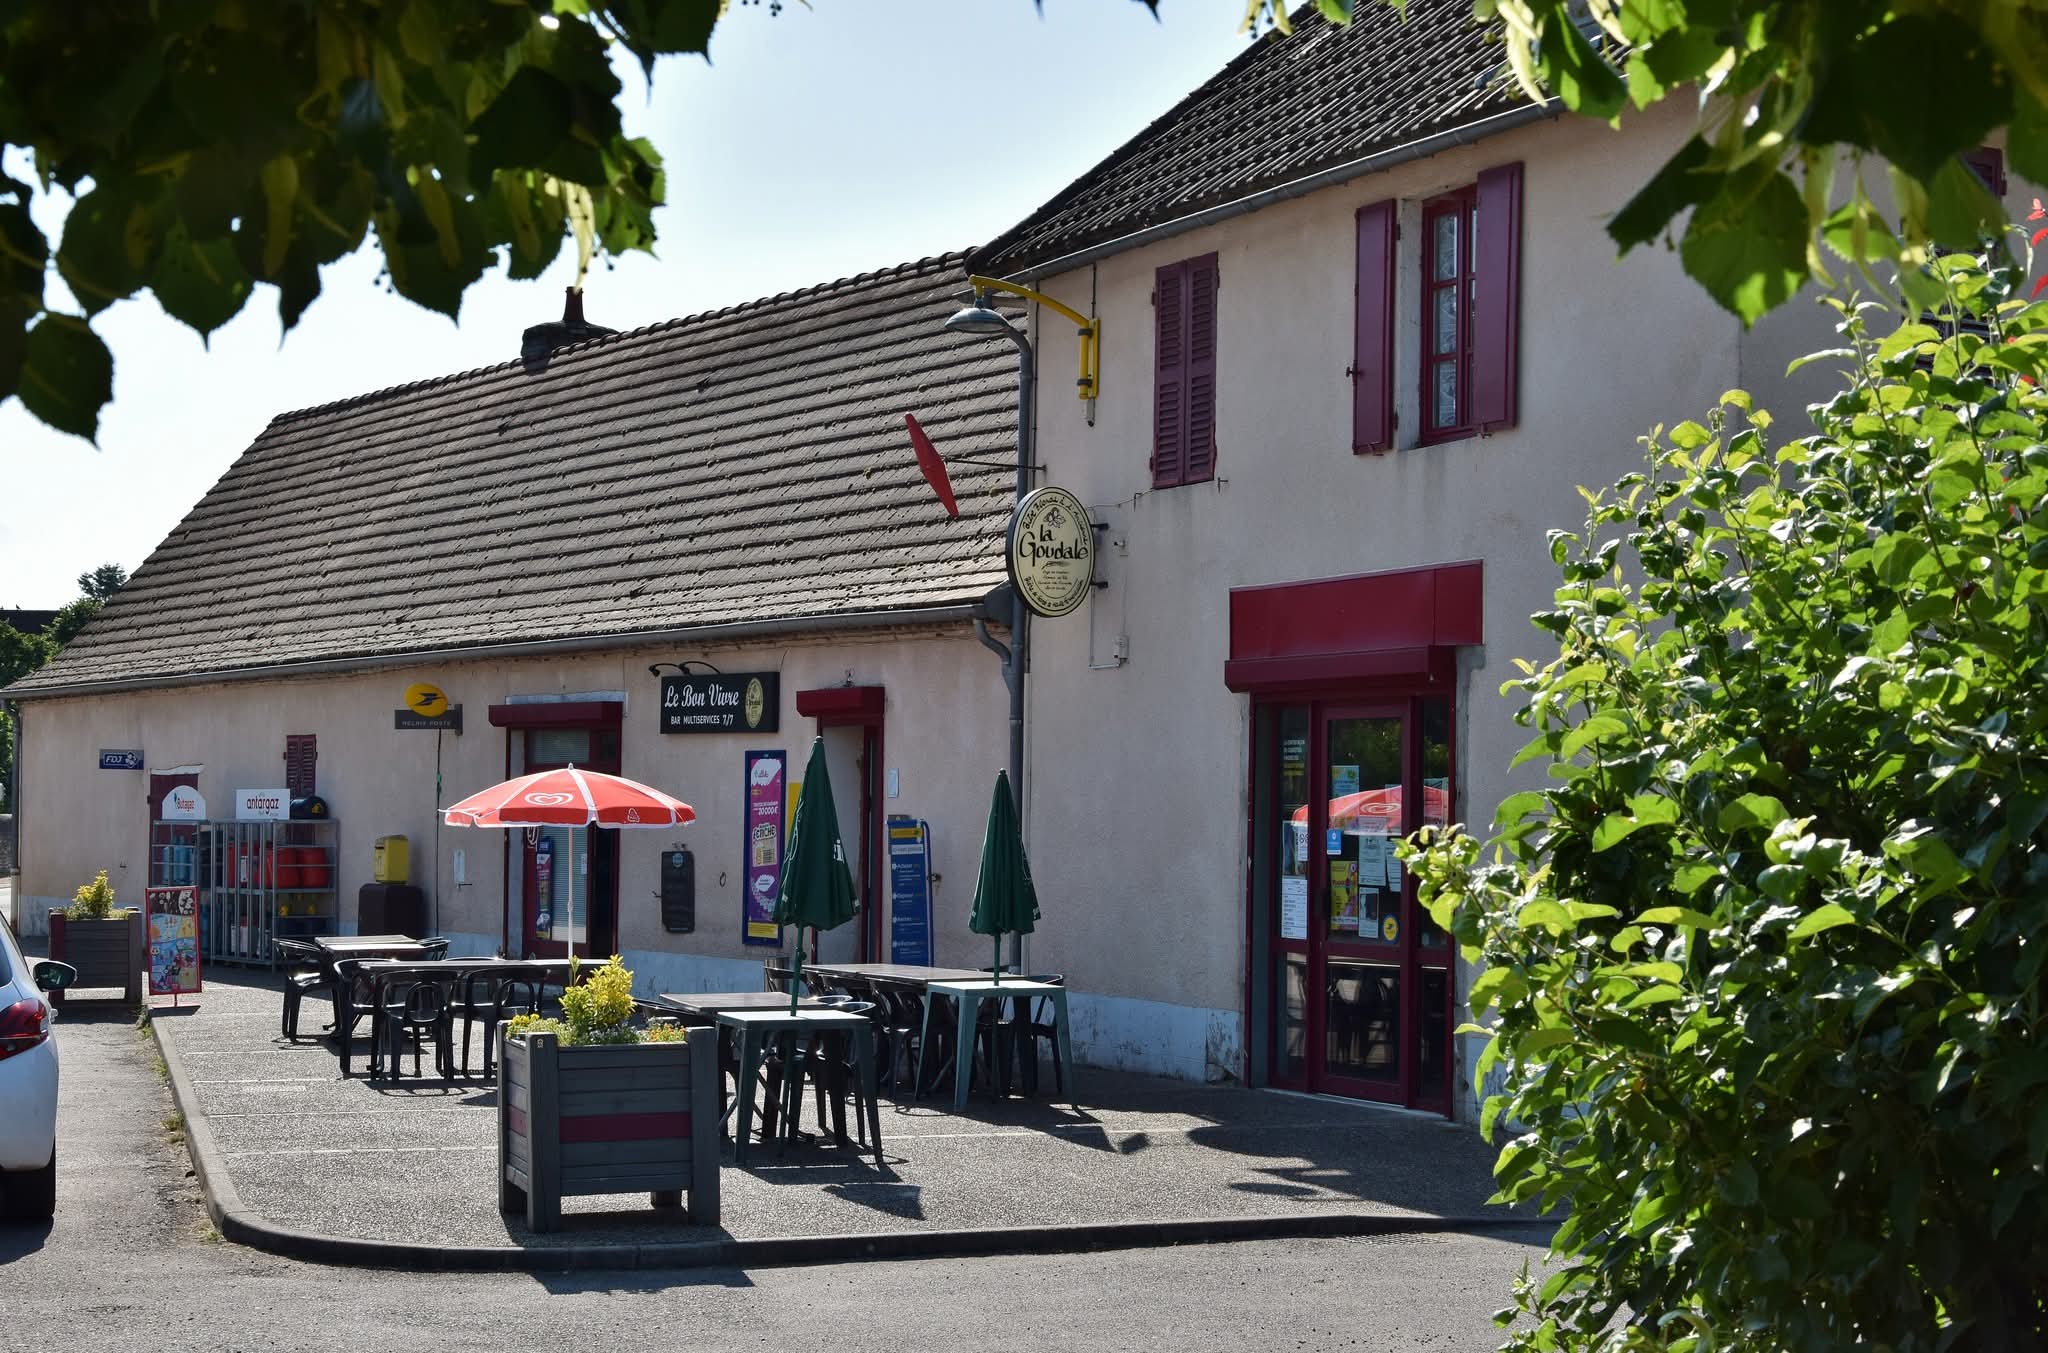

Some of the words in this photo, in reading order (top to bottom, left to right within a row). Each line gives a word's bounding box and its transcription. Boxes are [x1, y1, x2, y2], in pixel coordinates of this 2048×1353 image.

[1040, 524, 1056, 542] la
[1019, 531, 1088, 567] Goudale
[664, 685, 679, 707] Le
[681, 684, 706, 707] Bon
[708, 683, 740, 706] Vivre
[671, 716, 681, 725] BAR
[683, 715, 720, 725] MULTISERVICES
[722, 714, 734, 727] 7/7
[105, 755, 122, 763] FDJ
[176, 798, 195, 812] Butagaz
[246, 796, 279, 814] antargaz
